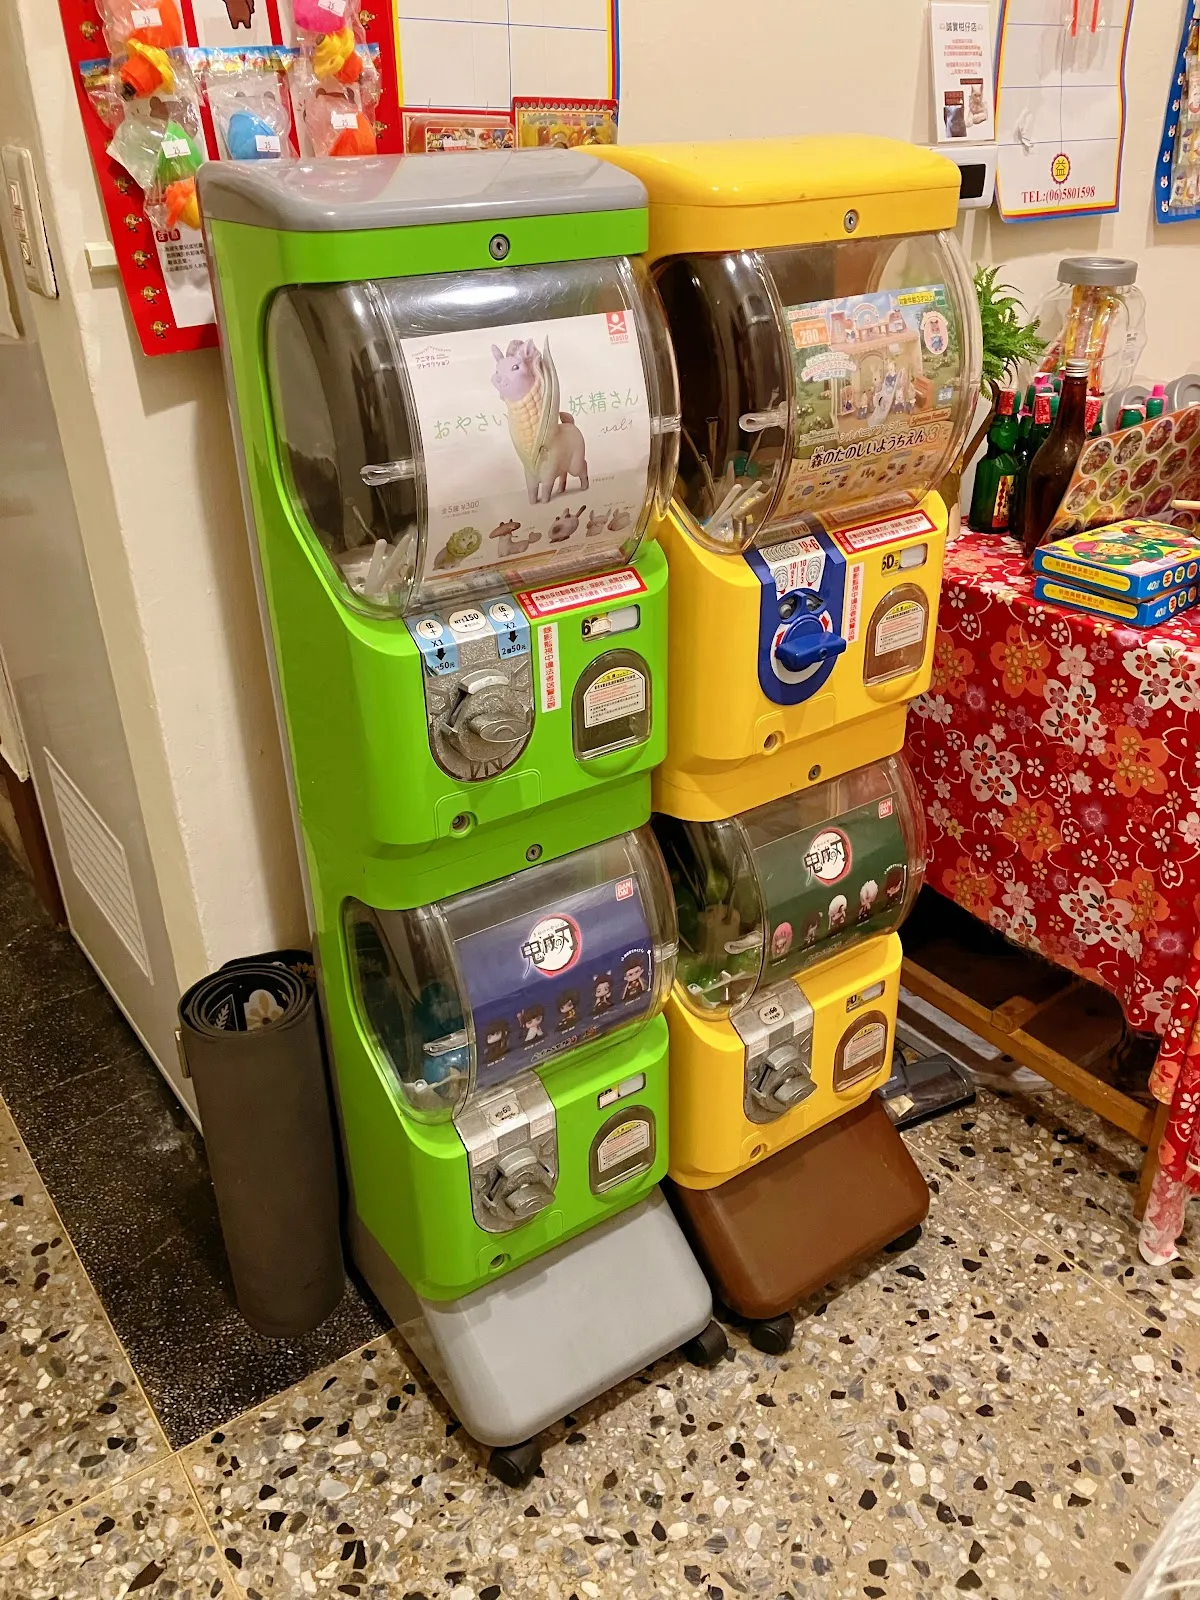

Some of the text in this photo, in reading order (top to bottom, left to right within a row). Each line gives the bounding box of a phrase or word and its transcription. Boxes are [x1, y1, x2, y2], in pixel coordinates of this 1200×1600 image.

[1055, 160, 1066, 176] 益
[1021, 186, 1096, 204] TEL:(06)5801598
[568, 388, 639, 416] 妖精さん
[811, 430, 925, 469] 森のたのしいようちえん
